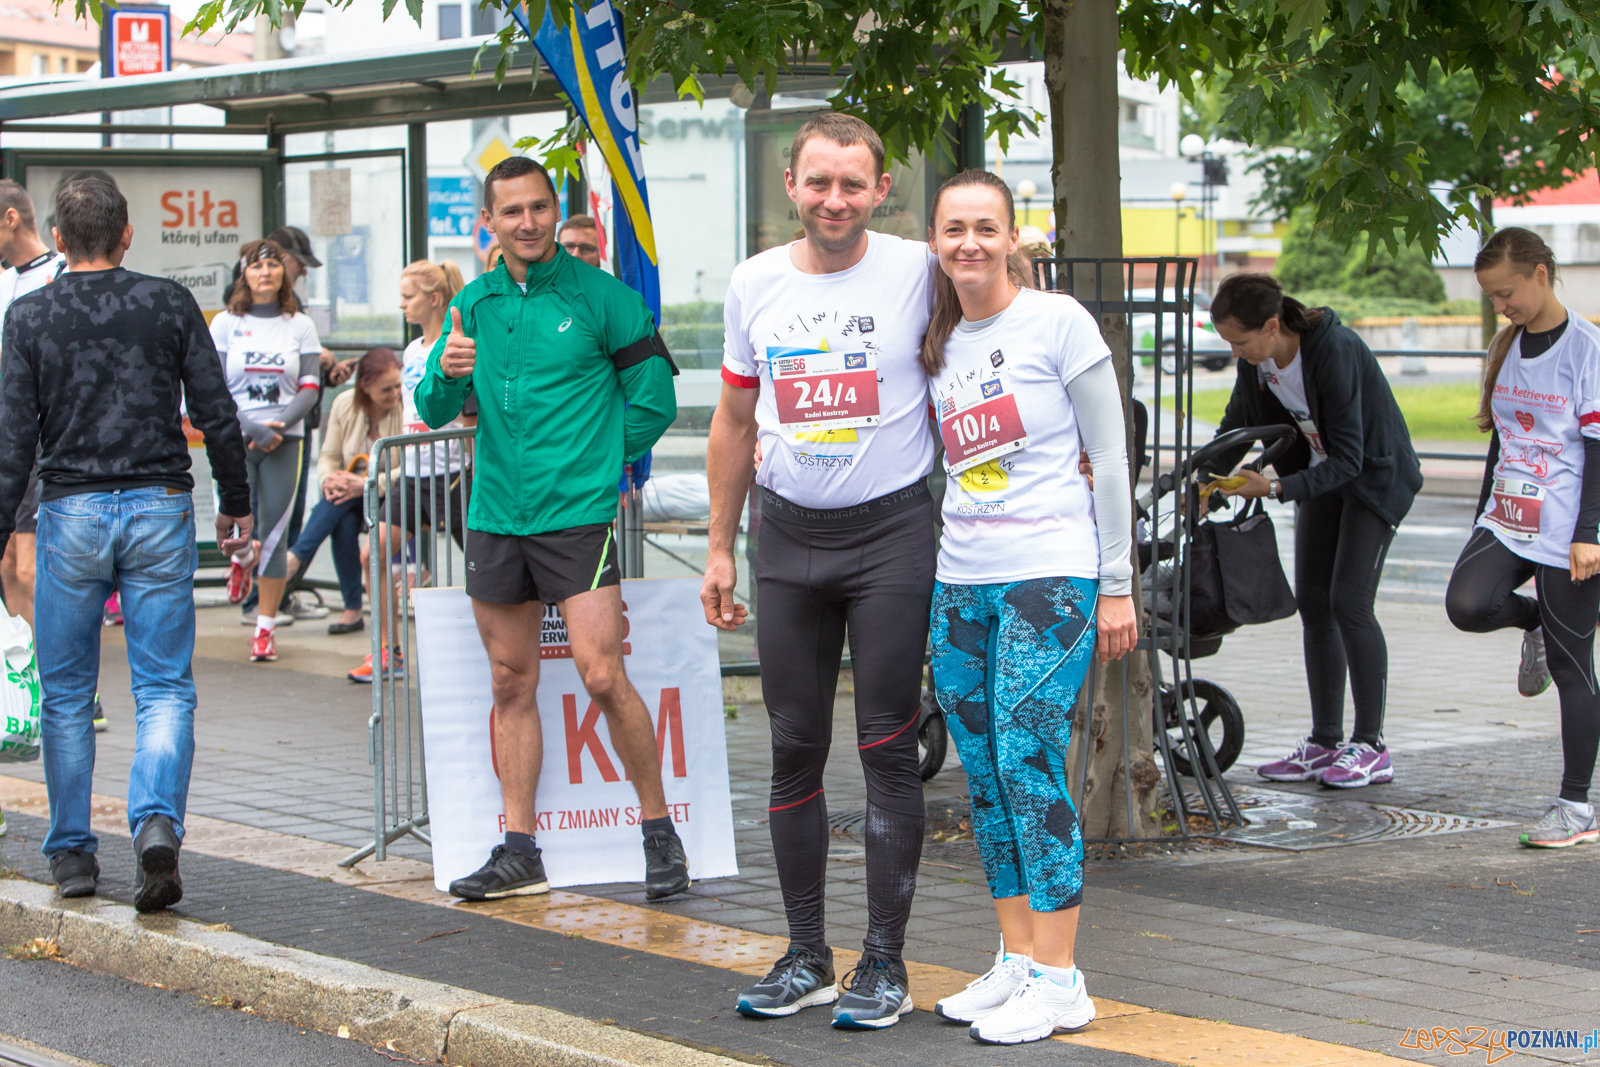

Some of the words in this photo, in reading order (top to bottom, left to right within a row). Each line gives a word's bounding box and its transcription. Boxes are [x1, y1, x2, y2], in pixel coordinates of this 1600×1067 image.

[160, 190, 239, 228] Siła
[161, 230, 201, 247] której
[204, 230, 239, 244] ufam
[242, 351, 285, 366] 1956
[793, 379, 858, 409] 24/4
[1494, 383, 1509, 395] den
[1512, 386, 1569, 406] Retrievery
[804, 411, 822, 419] Radni
[822, 409, 849, 418] Kostrzyn
[951, 413, 1001, 446] 10/4
[976, 439, 998, 451] Kostrzyn
[794, 455, 853, 468] KOSTRZYN
[957, 503, 1005, 515] KOSTRZYN
[1501, 498, 1523, 522] 11/4
[562, 687, 686, 784] KM
[498, 811, 553, 833] PKT
[558, 807, 620, 830] ZMIANY
[624, 802, 691, 826] SZFET
